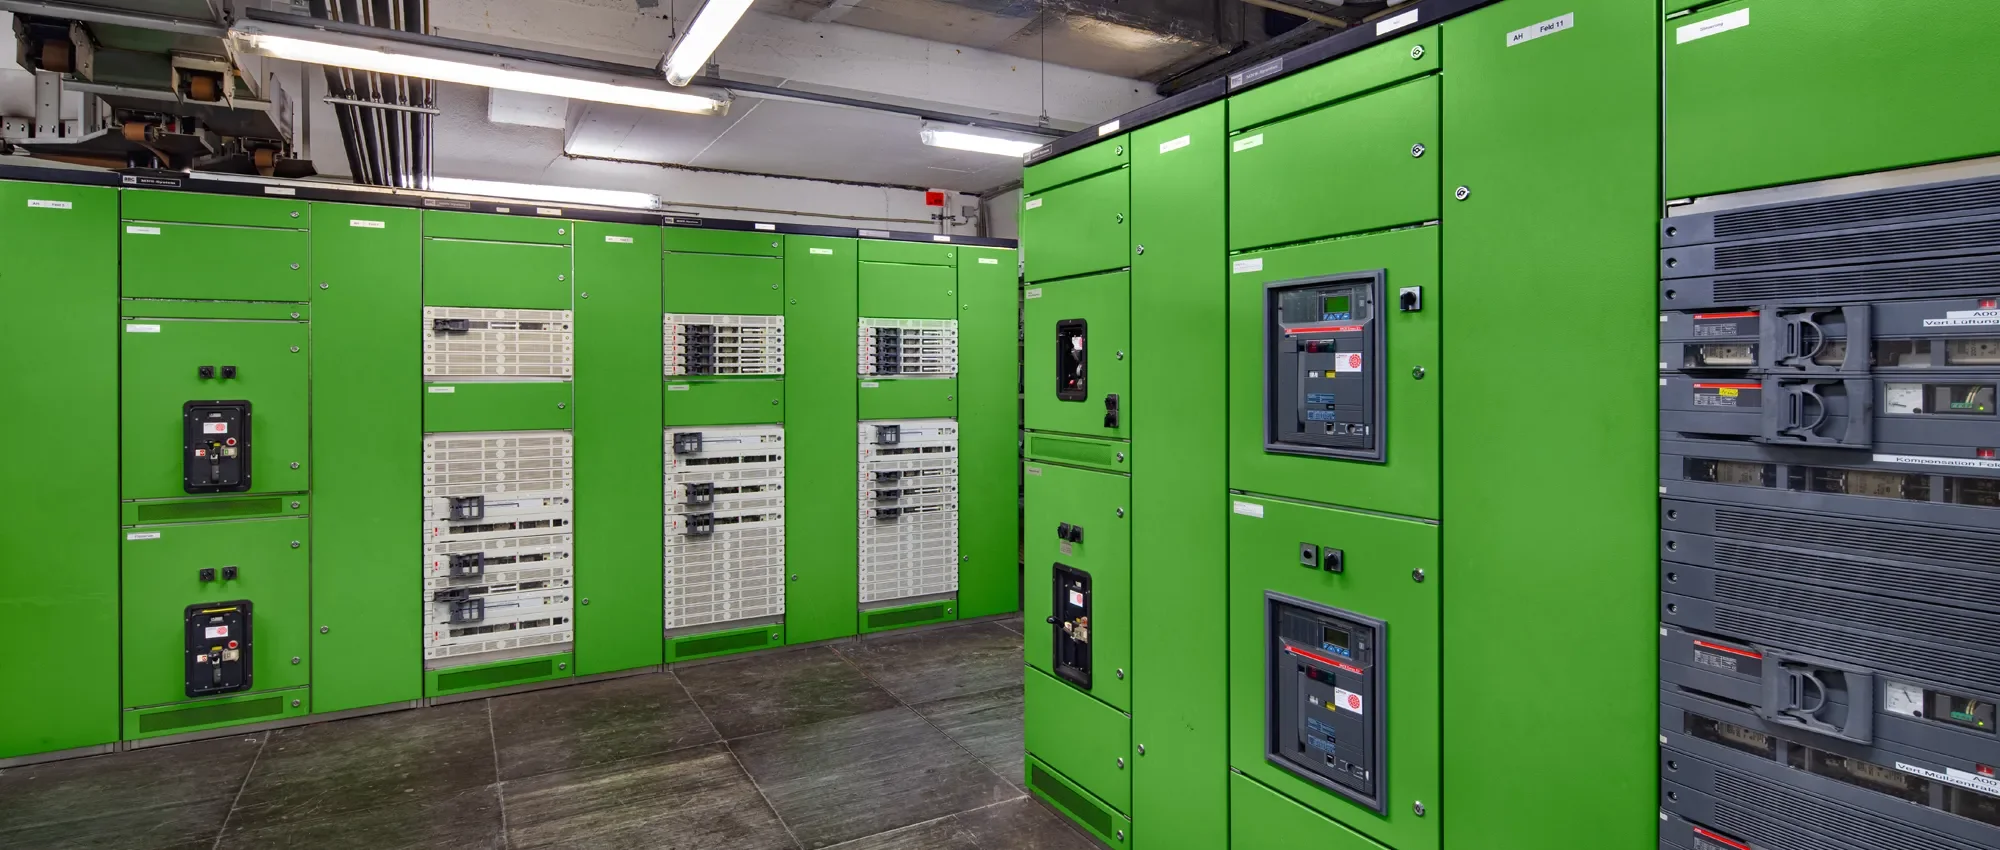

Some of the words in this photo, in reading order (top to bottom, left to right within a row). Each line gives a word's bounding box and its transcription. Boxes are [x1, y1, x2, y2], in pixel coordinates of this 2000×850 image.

[1513, 33, 1524, 41] AH
[1540, 23, 1554, 33] Feld
[1556, 20, 1564, 28] 11
[1896, 457, 1976, 467] Kompensation
[1973, 776, 1997, 786] A00
